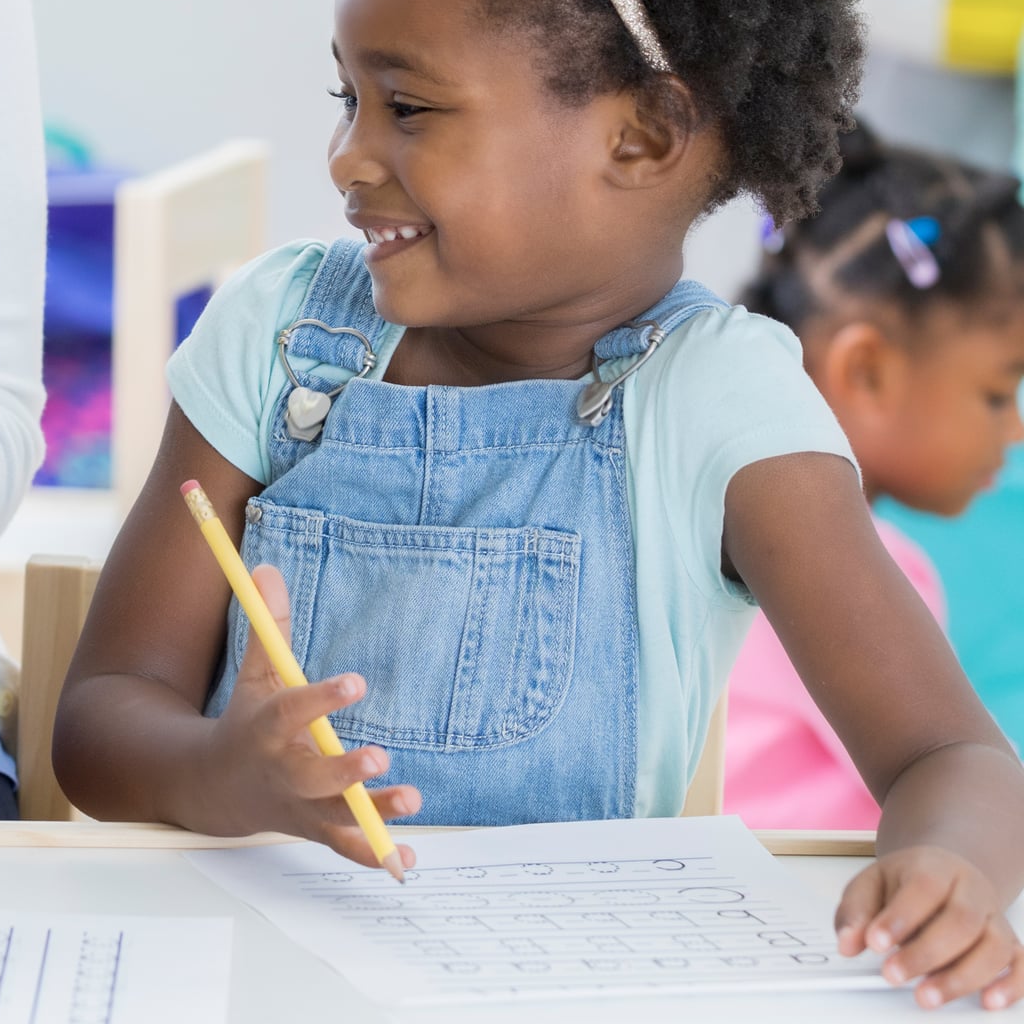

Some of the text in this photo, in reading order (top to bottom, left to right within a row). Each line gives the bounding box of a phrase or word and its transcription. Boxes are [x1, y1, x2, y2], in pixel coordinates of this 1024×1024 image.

[653, 860, 685, 871] c
[678, 887, 745, 904] C
[718, 910, 766, 925] b
[757, 931, 807, 947] B
[789, 954, 829, 966] a
